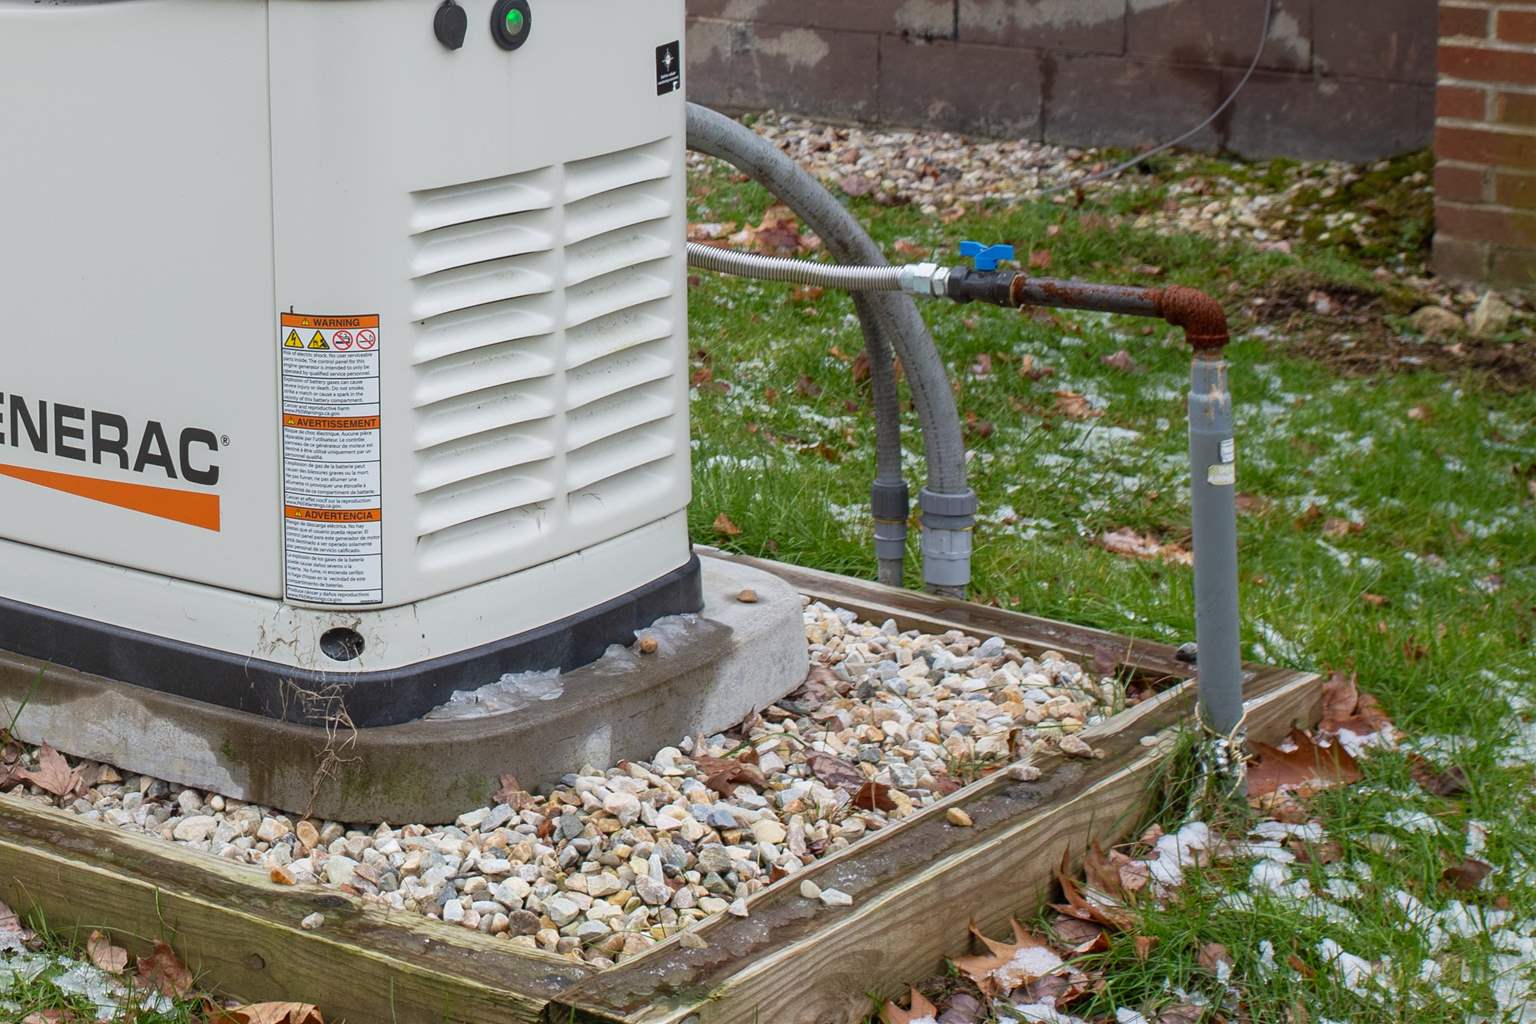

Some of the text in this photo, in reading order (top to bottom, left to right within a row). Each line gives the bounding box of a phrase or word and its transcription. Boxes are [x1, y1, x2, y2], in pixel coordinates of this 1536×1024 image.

[313, 318, 360, 327] WARNING
[297, 418, 376, 428] AVERTISSEMENT
[304, 511, 373, 520] ADVERTENCIA
